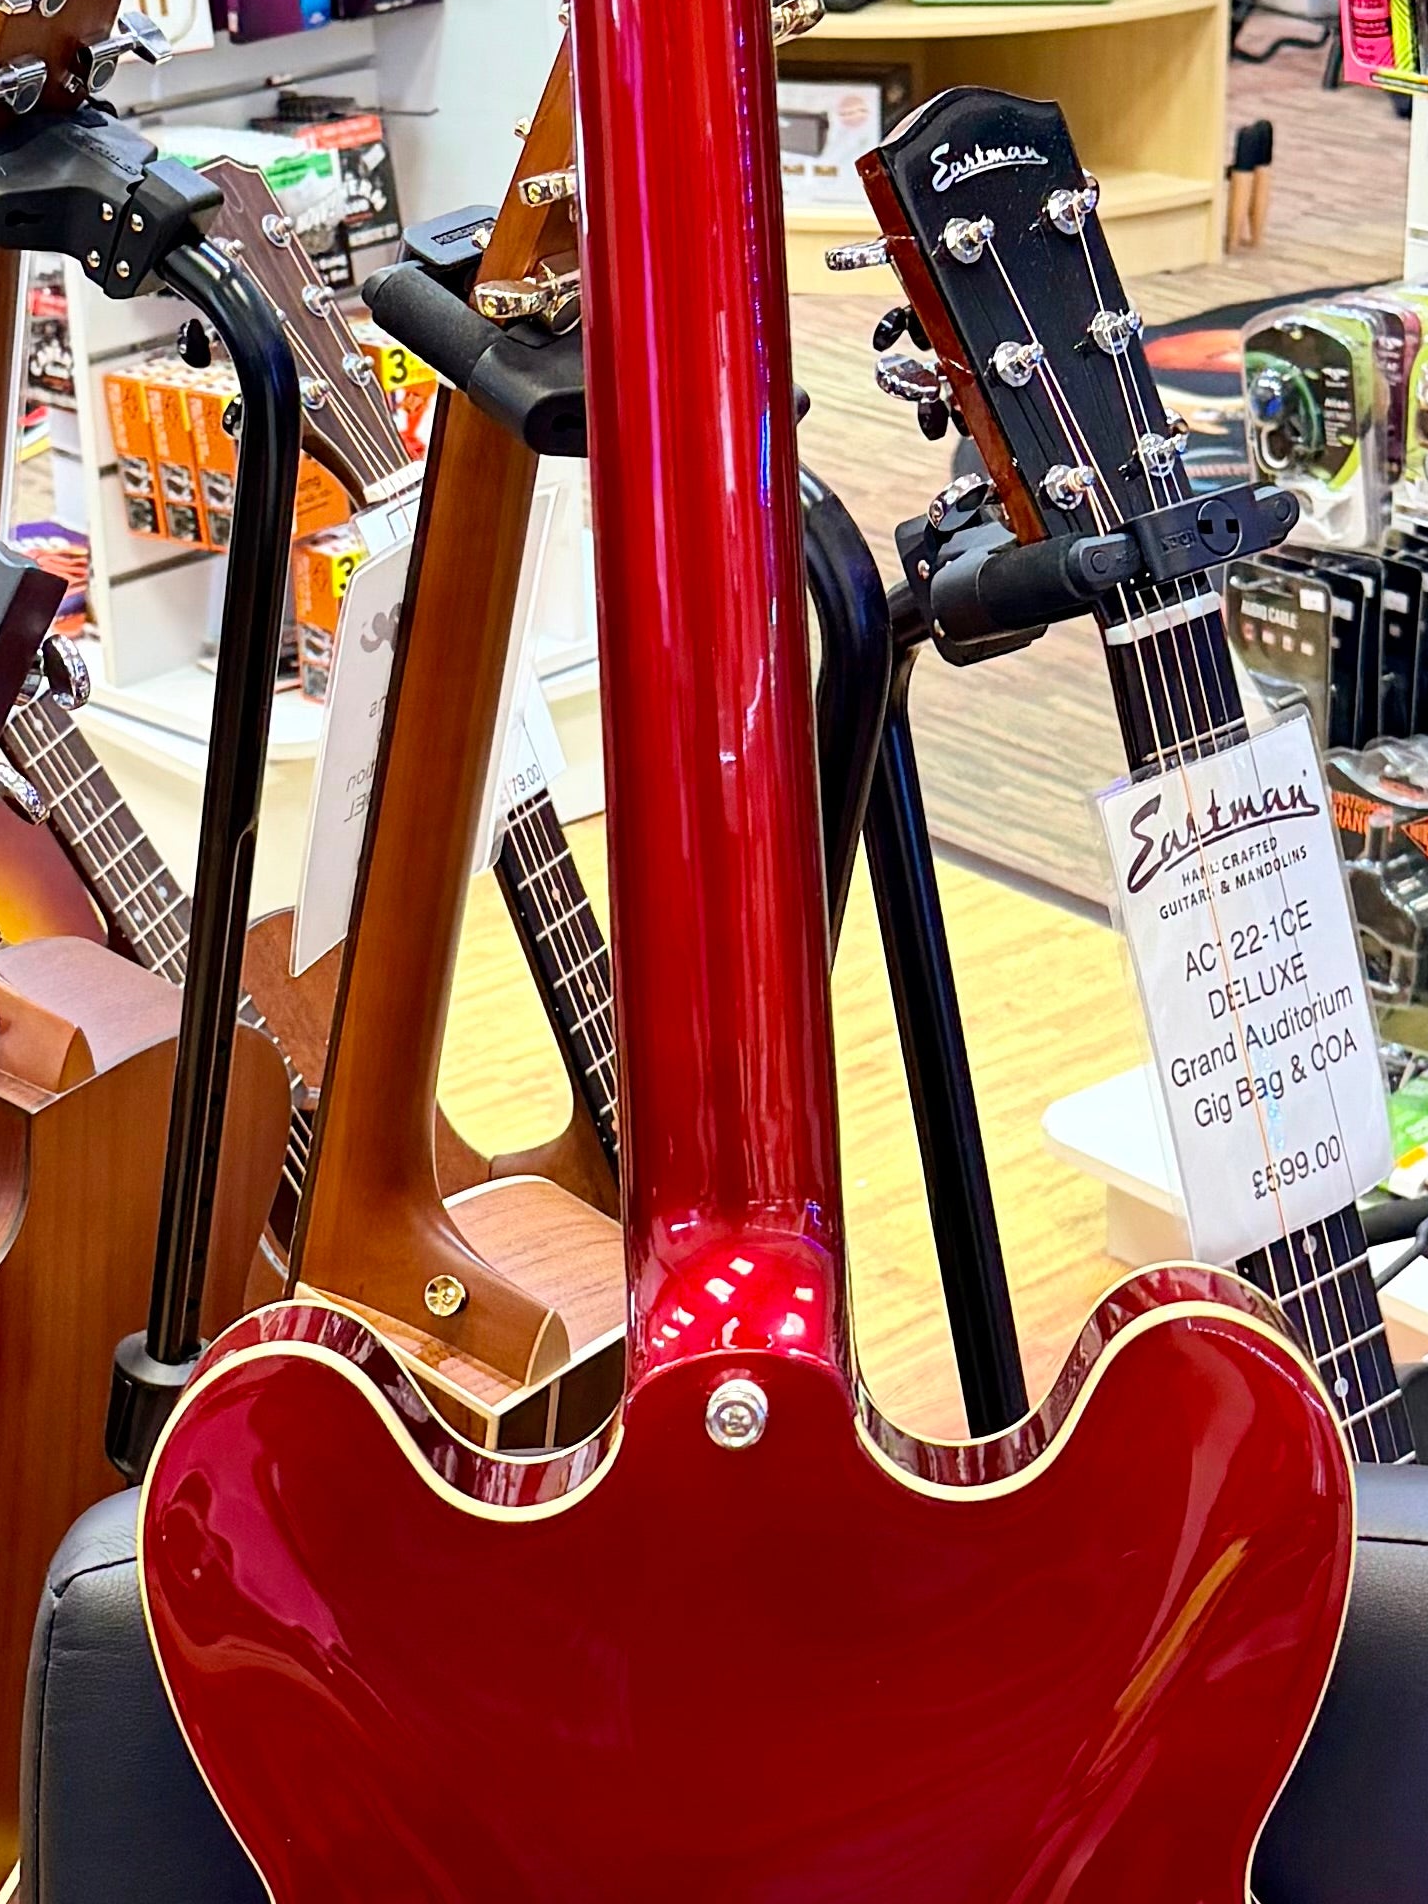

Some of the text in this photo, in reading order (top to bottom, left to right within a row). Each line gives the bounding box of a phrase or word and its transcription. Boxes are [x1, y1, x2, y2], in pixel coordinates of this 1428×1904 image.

[929, 140, 1050, 194] Eastman
[386, 347, 410, 385] 3
[1266, 606, 1299, 630] CABLE
[1127, 769, 1321, 895] Eastman
[1158, 845, 1308, 921] GUITARS & MANDOLINS
[1207, 951, 1309, 1021] DELUXE
[1170, 982, 1354, 1090] Grand Auditorium
[1193, 1027, 1359, 1130] Gig Bag & COA
[1250, 1134, 1342, 1201] £599.00
